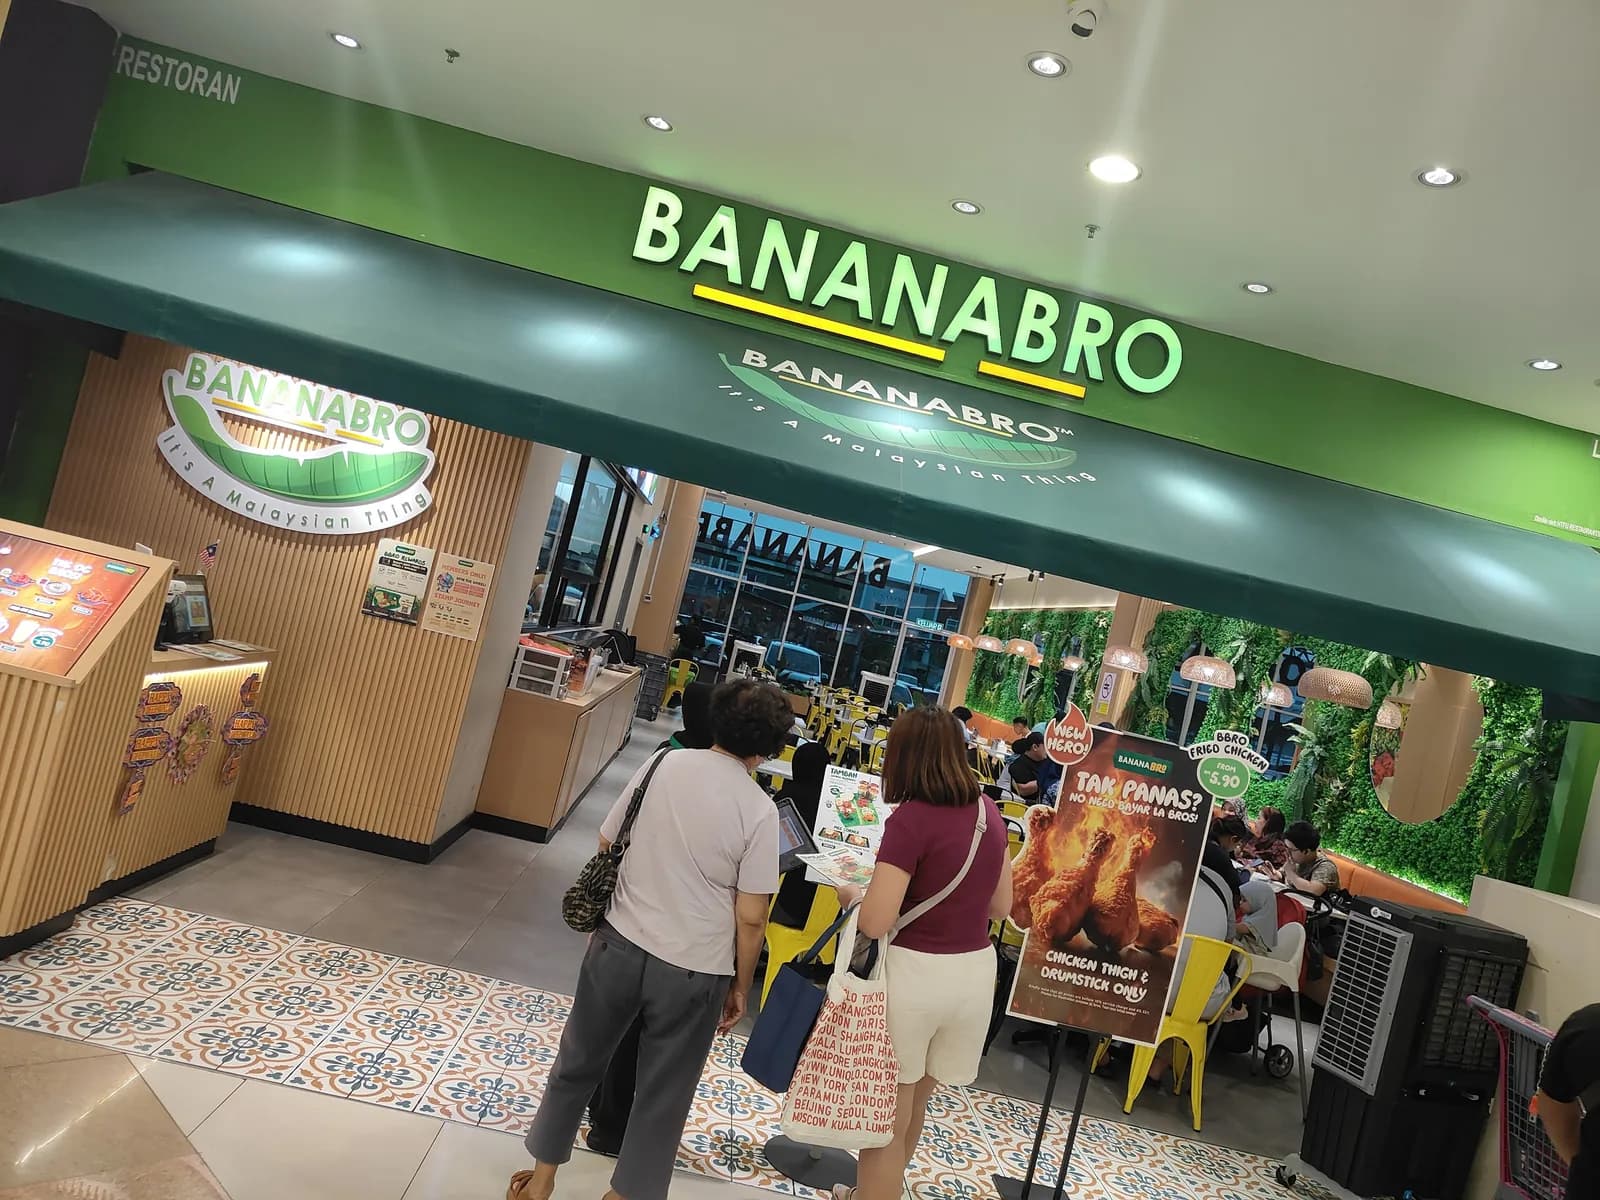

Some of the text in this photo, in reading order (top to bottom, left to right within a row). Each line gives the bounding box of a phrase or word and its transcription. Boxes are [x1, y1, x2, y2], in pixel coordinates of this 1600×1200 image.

[116, 45, 241, 105] RESTORAN
[632, 186, 1183, 393] BANANABRO
[186, 357, 426, 445] BANANABRO
[742, 349, 1058, 442] BANANABRO
[718, 385, 1097, 485] It's A Malaysian Thing
[163, 434, 427, 529] It's A Malaysian Thing
[1054, 726, 1087, 741] NEW
[1217, 733, 1247, 746] BBRO
[1048, 739, 1089, 756] HERO!
[1190, 745, 1267, 771] FRIED CHICKEN
[1118, 755, 1168, 775] BANANABRO
[1216, 762, 1237, 773] FROM
[1077, 771, 1202, 811] TAK PANAS?
[1069, 792, 1199, 823] NO NEED BAYAR LA BROS!
[1046, 950, 1149, 985] CHICKEN THIGH &
[1040, 966, 1148, 1003] DRUMSTICK ONLY
[840, 1043, 874, 1056] LUMPUR
[797, 1087, 845, 1105] PARAMUS
[801, 1074, 820, 1085] NEW
[824, 1079, 848, 1092] YORK
[792, 1112, 828, 1127] MOSCOW
[831, 1120, 861, 1130] KUALA
[794, 1099, 831, 1116] BEIJING
[837, 1107, 868, 1118] SEOUL
